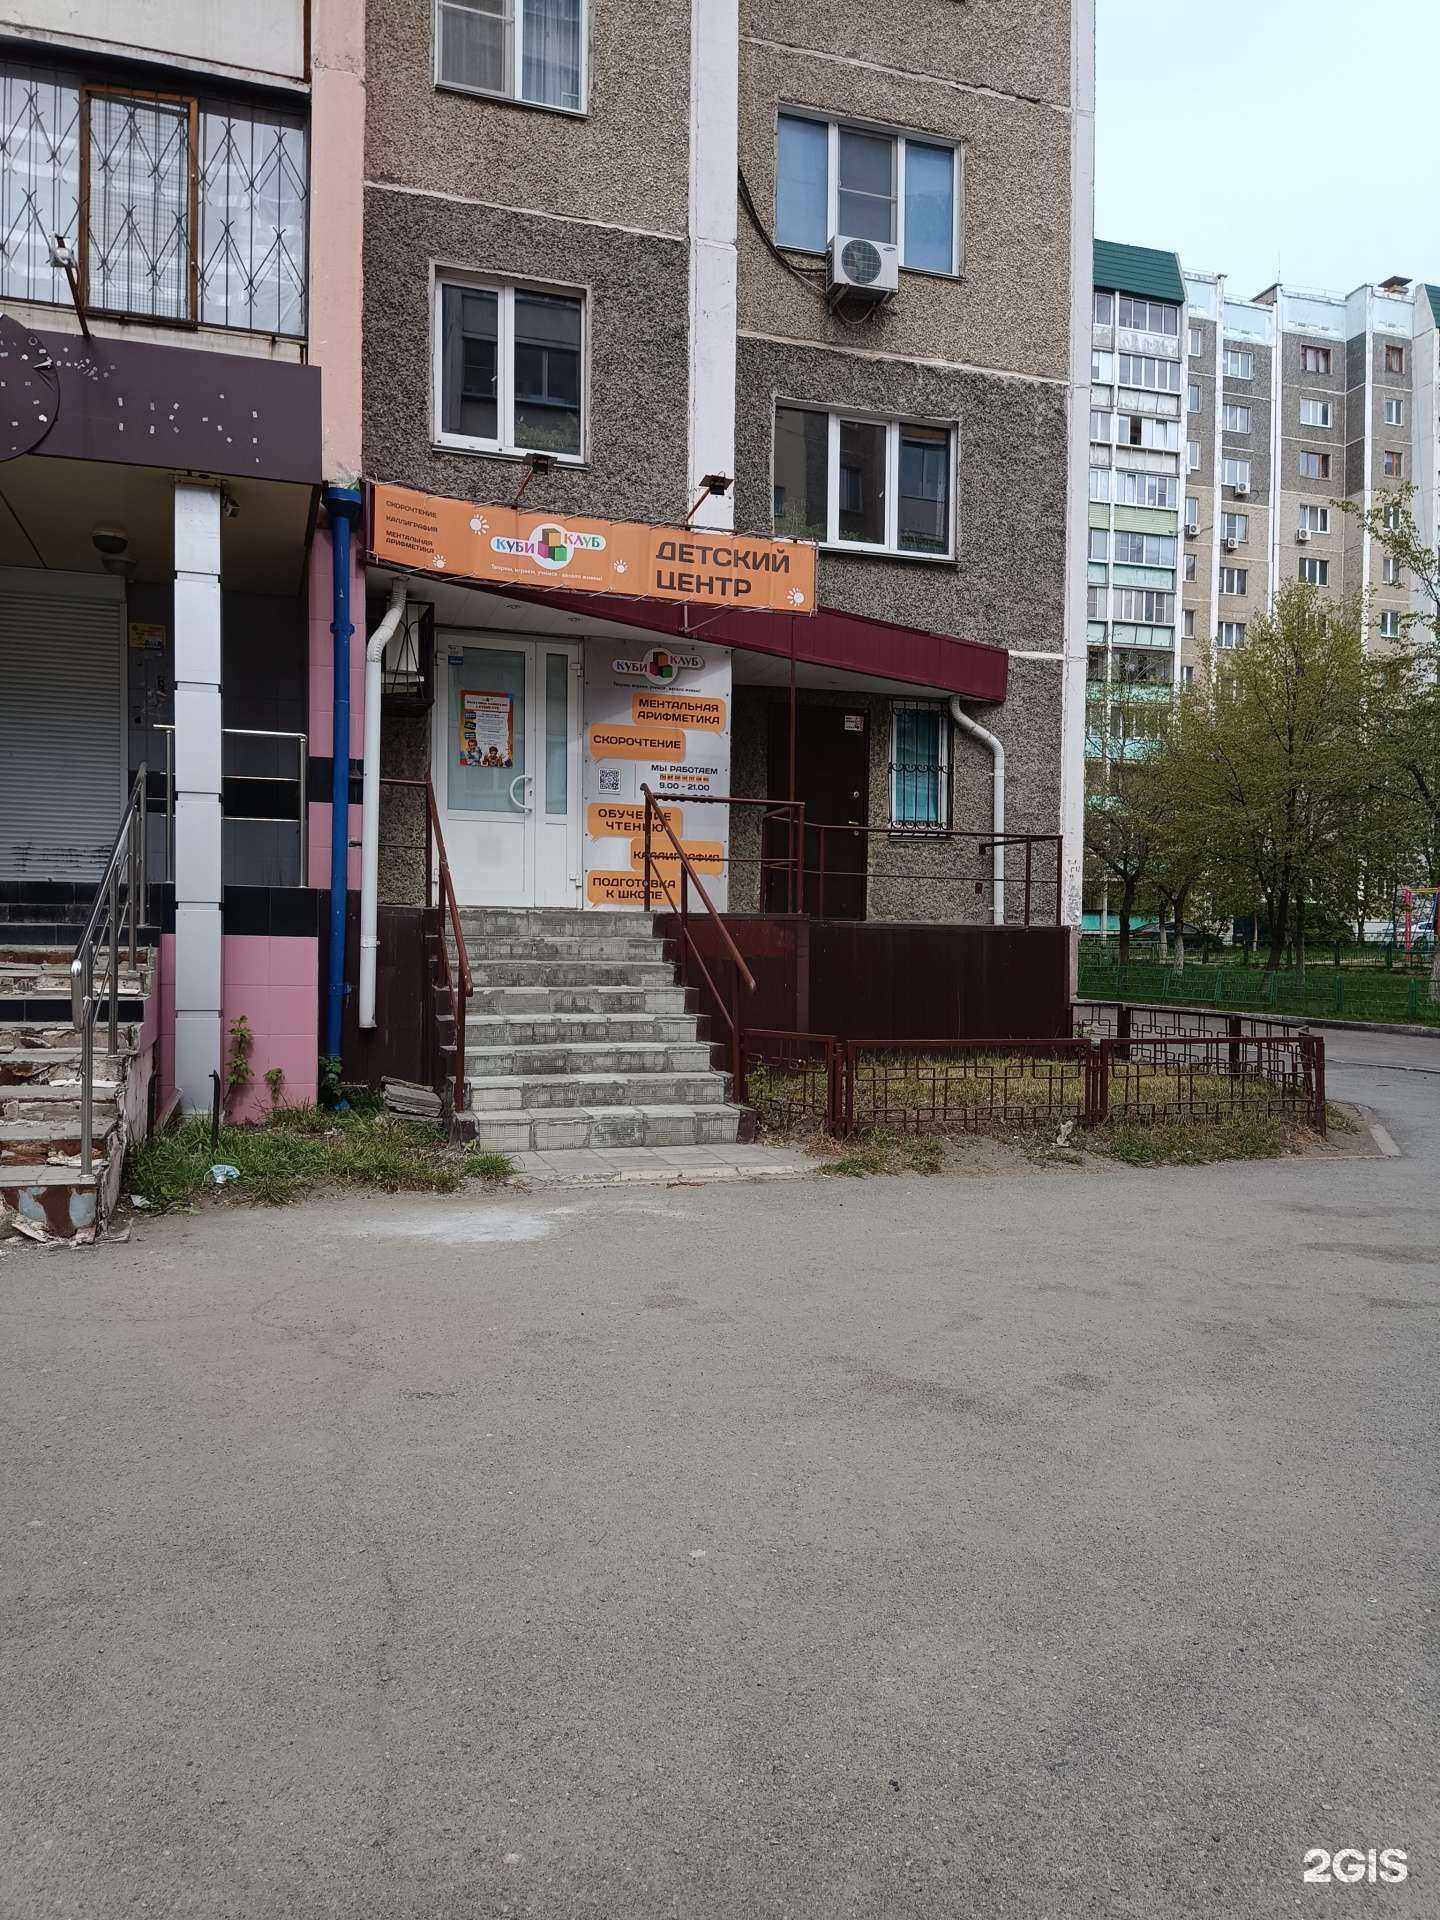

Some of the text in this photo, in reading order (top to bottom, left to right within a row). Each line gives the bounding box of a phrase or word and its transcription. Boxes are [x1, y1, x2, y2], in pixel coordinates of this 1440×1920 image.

[386, 500, 438, 518] СКОРОЧТЕНИЕ
[386, 515, 438, 533] КАЛЛИГРАФИЯ
[386, 530, 433, 546] МЕНТАЛЬНАЯ
[386, 537, 435, 554] АРИФМЕТИКА
[496, 533, 600, 553] КУБИ КЛУБ
[656, 541, 790, 573] ДЕТСКИЙ
[656, 570, 752, 597] ЦЕНТР
[616, 655, 699, 673] КУБИ КЛУБ
[639, 698, 719, 713] МЕНТАЛЬНАЯ
[637, 711, 720, 725] АРИФМЕТИКА
[593, 735, 681, 749] СКОРОЧТЕНИЕ
[651, 764, 718, 775] МЫ РАБОТАЕМ
[659, 782, 680, 790] 9.00
[687, 783, 710, 791] 21.00
[606, 890, 614, 898] К
